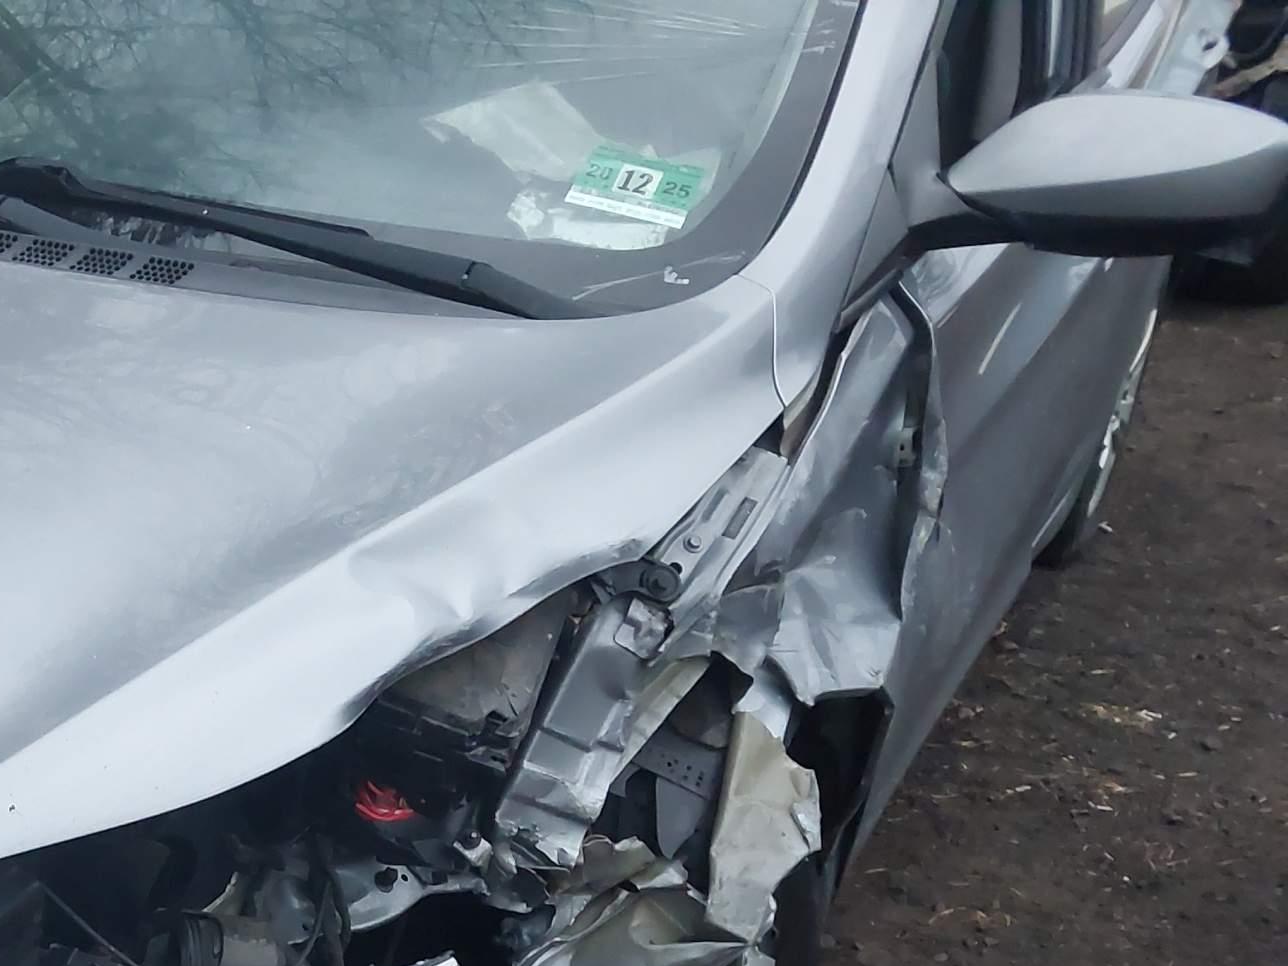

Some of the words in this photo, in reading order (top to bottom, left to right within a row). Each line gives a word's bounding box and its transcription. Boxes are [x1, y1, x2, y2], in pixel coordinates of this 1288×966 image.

[585, 163, 614, 180] 20
[617, 170, 654, 195] 12
[663, 182, 693, 199] 25
